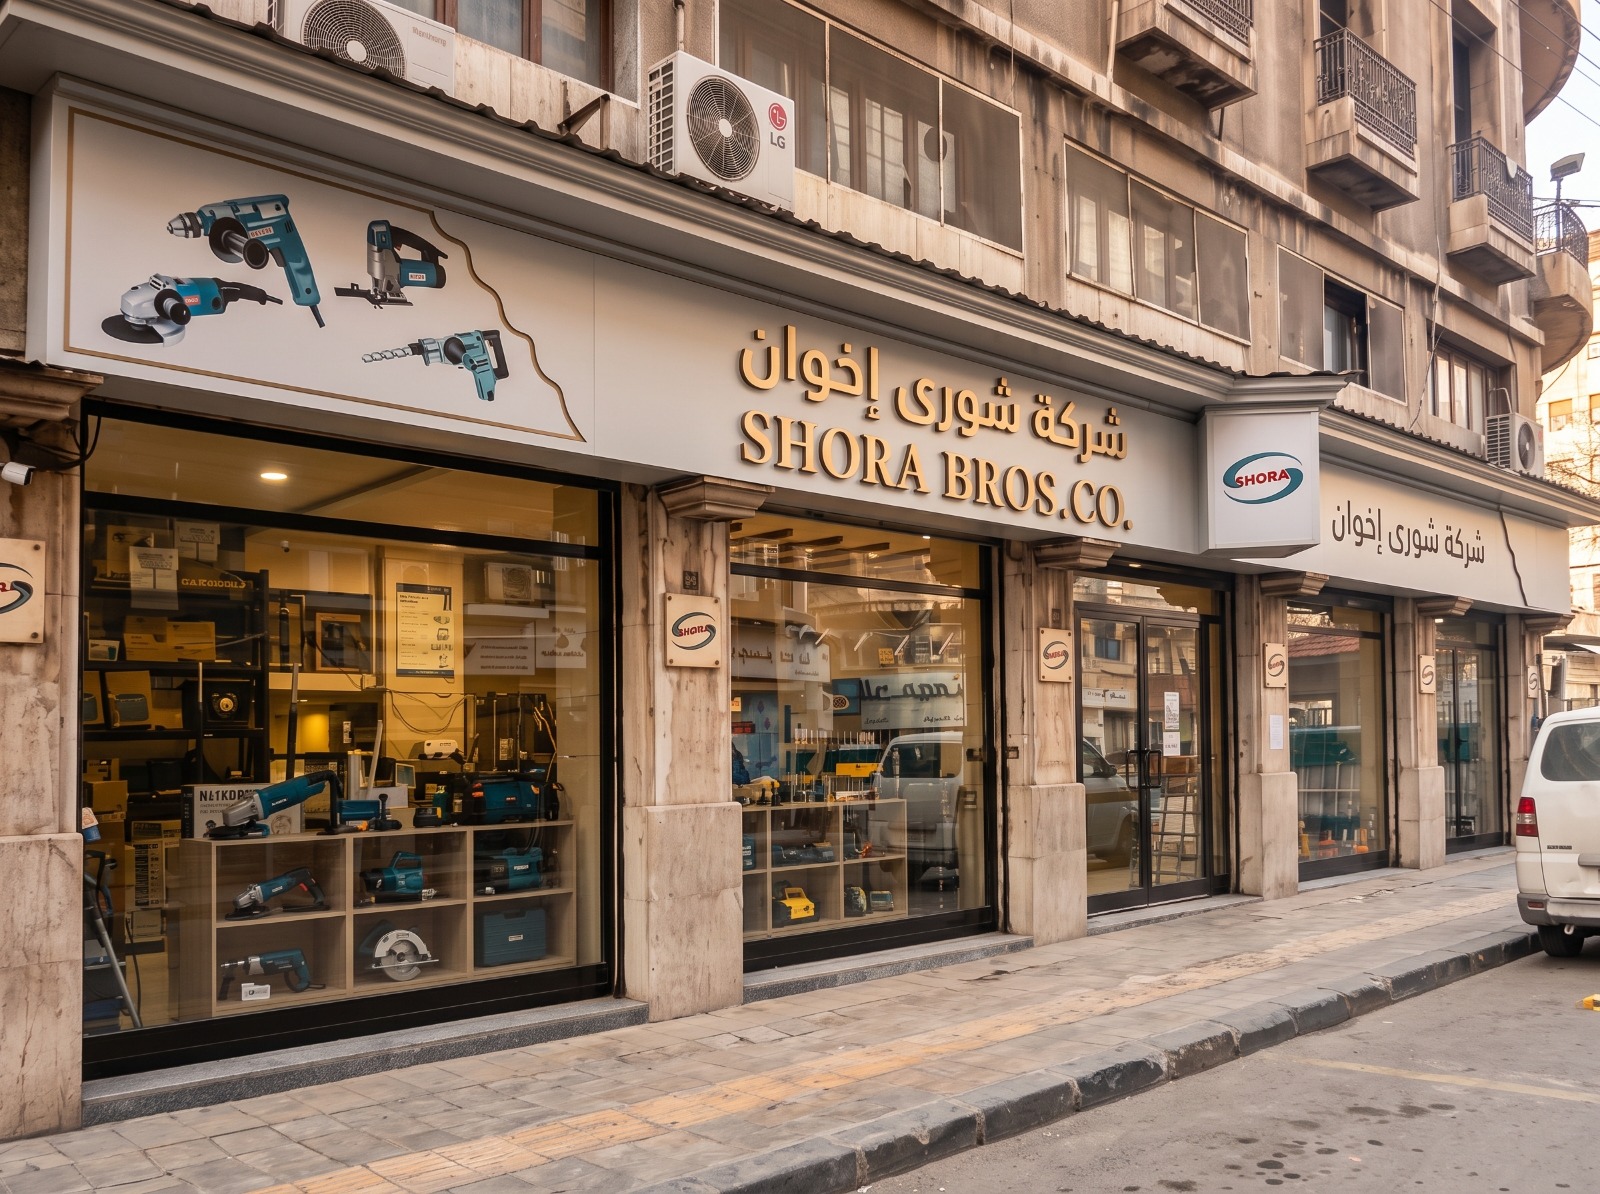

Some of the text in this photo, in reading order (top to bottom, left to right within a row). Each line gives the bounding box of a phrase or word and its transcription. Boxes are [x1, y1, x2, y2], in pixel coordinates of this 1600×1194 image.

[770, 131, 786, 149] LG
[738, 324, 1128, 463] شركة شورى إخوان
[740, 410, 1134, 531] SHORA BROS.CO.
[1235, 468, 1290, 488] SHORA
[1332, 500, 1485, 568] شركة شورى إخوان
